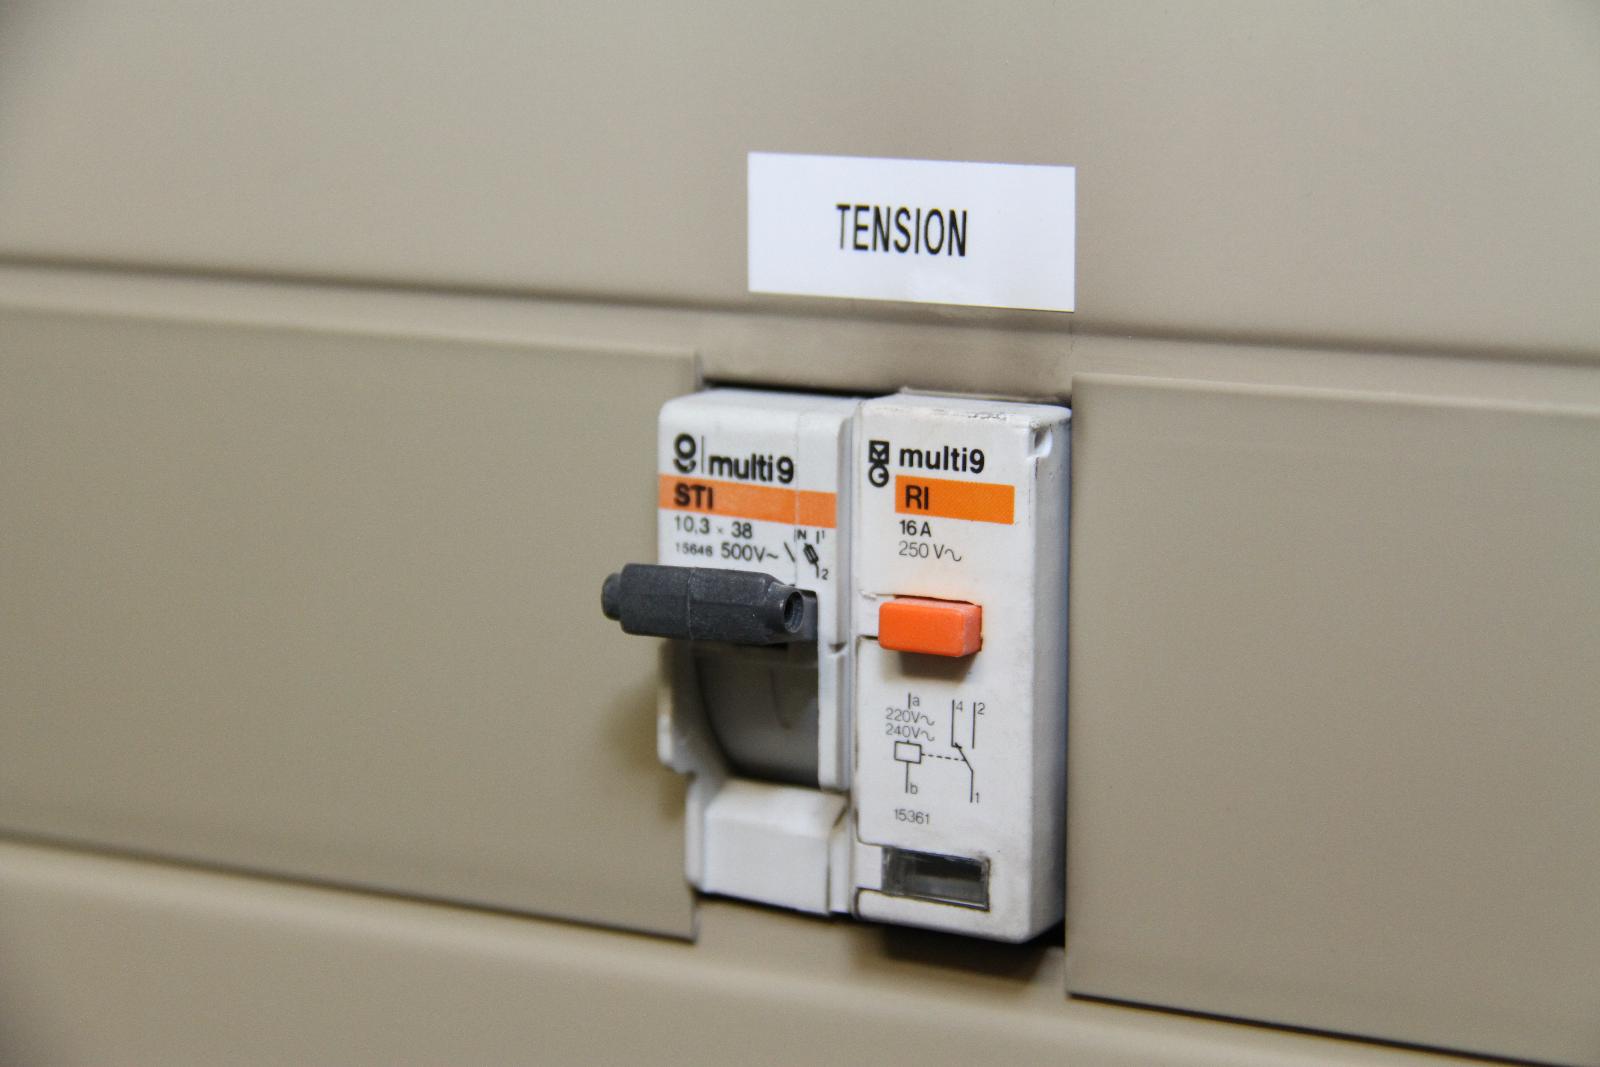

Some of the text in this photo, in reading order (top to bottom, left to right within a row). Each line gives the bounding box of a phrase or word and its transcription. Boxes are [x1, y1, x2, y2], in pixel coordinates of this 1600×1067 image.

[836, 203, 967, 257] TENSION
[709, 453, 794, 484] multi9
[900, 446, 985, 474] multi9
[674, 483, 714, 510] STI
[905, 485, 929, 510] RI
[731, 521, 753, 539] 38
[821, 569, 829, 580] 2
[912, 697, 920, 707] a
[955, 701, 963, 712] 4
[977, 702, 985, 715] 2
[910, 782, 918, 795] b
[894, 808, 930, 824] 15361
